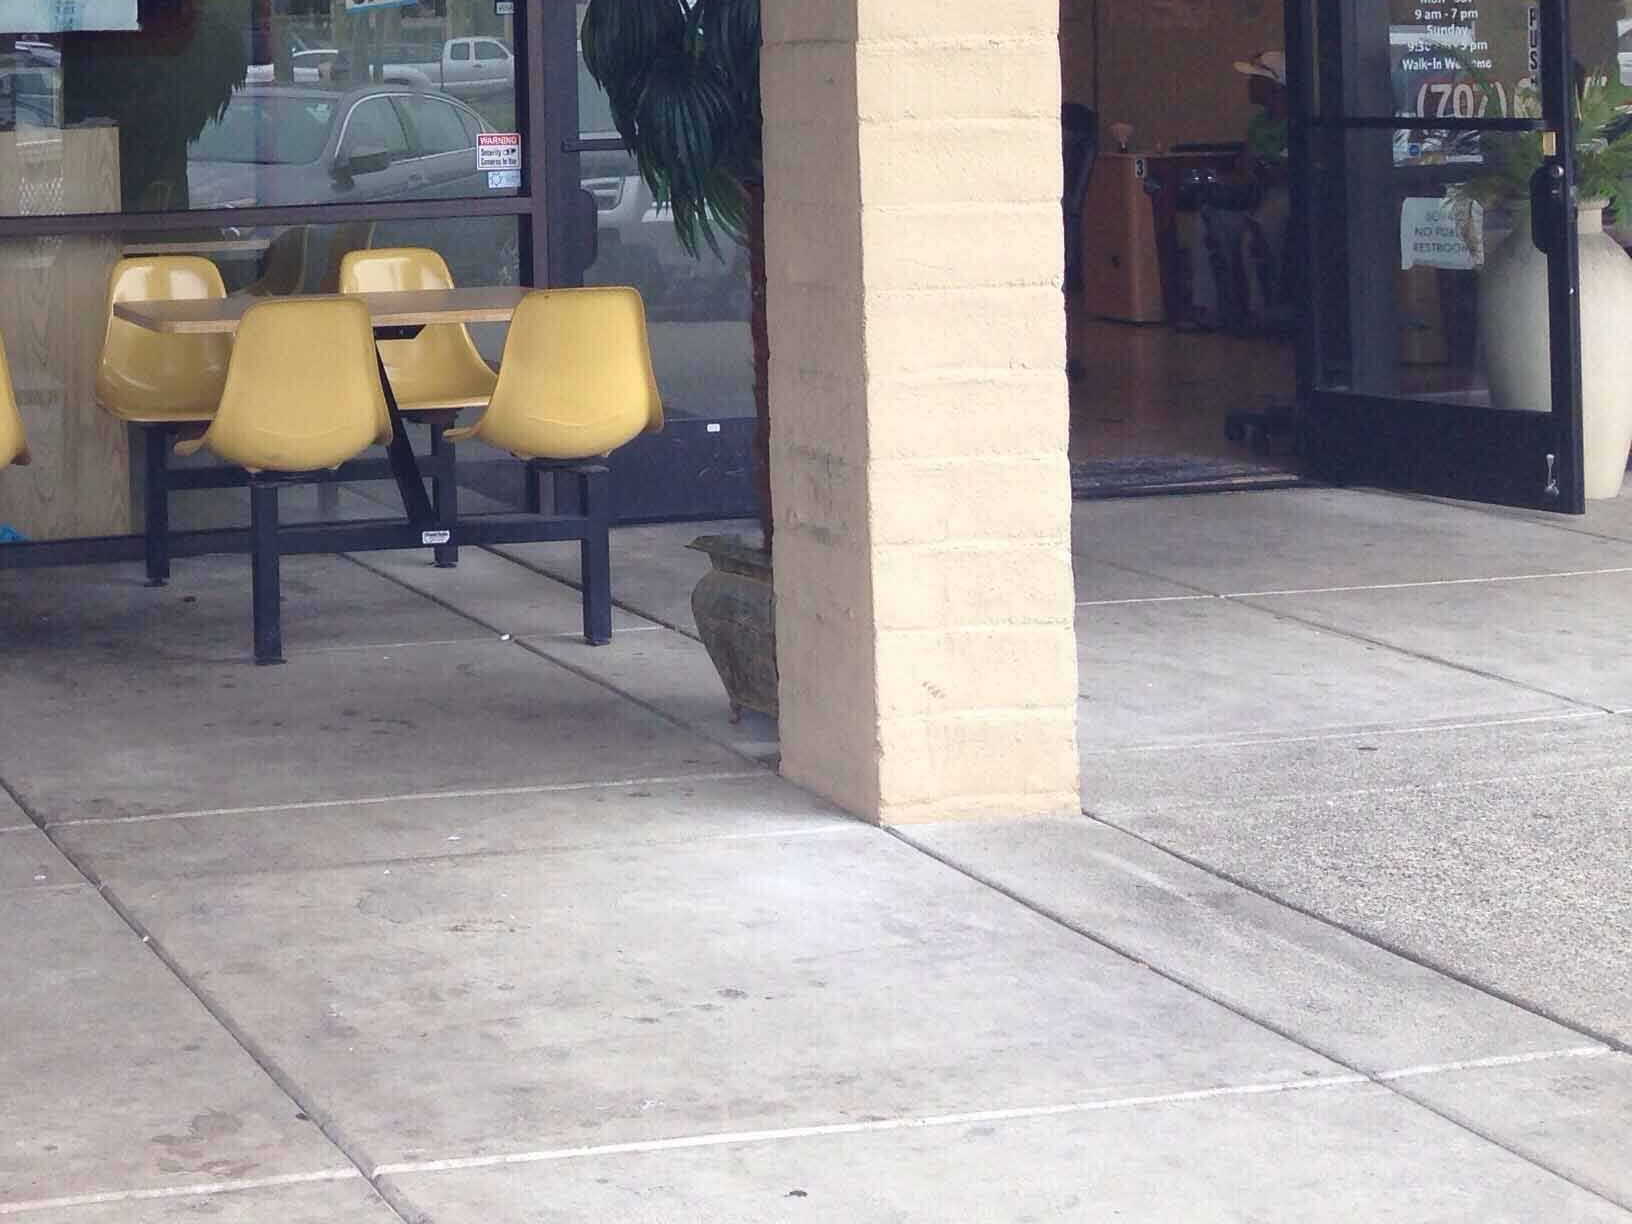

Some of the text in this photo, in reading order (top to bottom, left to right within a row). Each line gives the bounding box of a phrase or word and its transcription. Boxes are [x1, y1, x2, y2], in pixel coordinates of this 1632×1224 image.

[1414, 9, 1422, 20] 9
[1424, 11, 1442, 19] am
[1451, 8, 1458, 19] 7
[1460, 10, 1479, 21] pm
[1470, 41, 1488, 53] pm
[1136, 159, 1144, 176] 3
